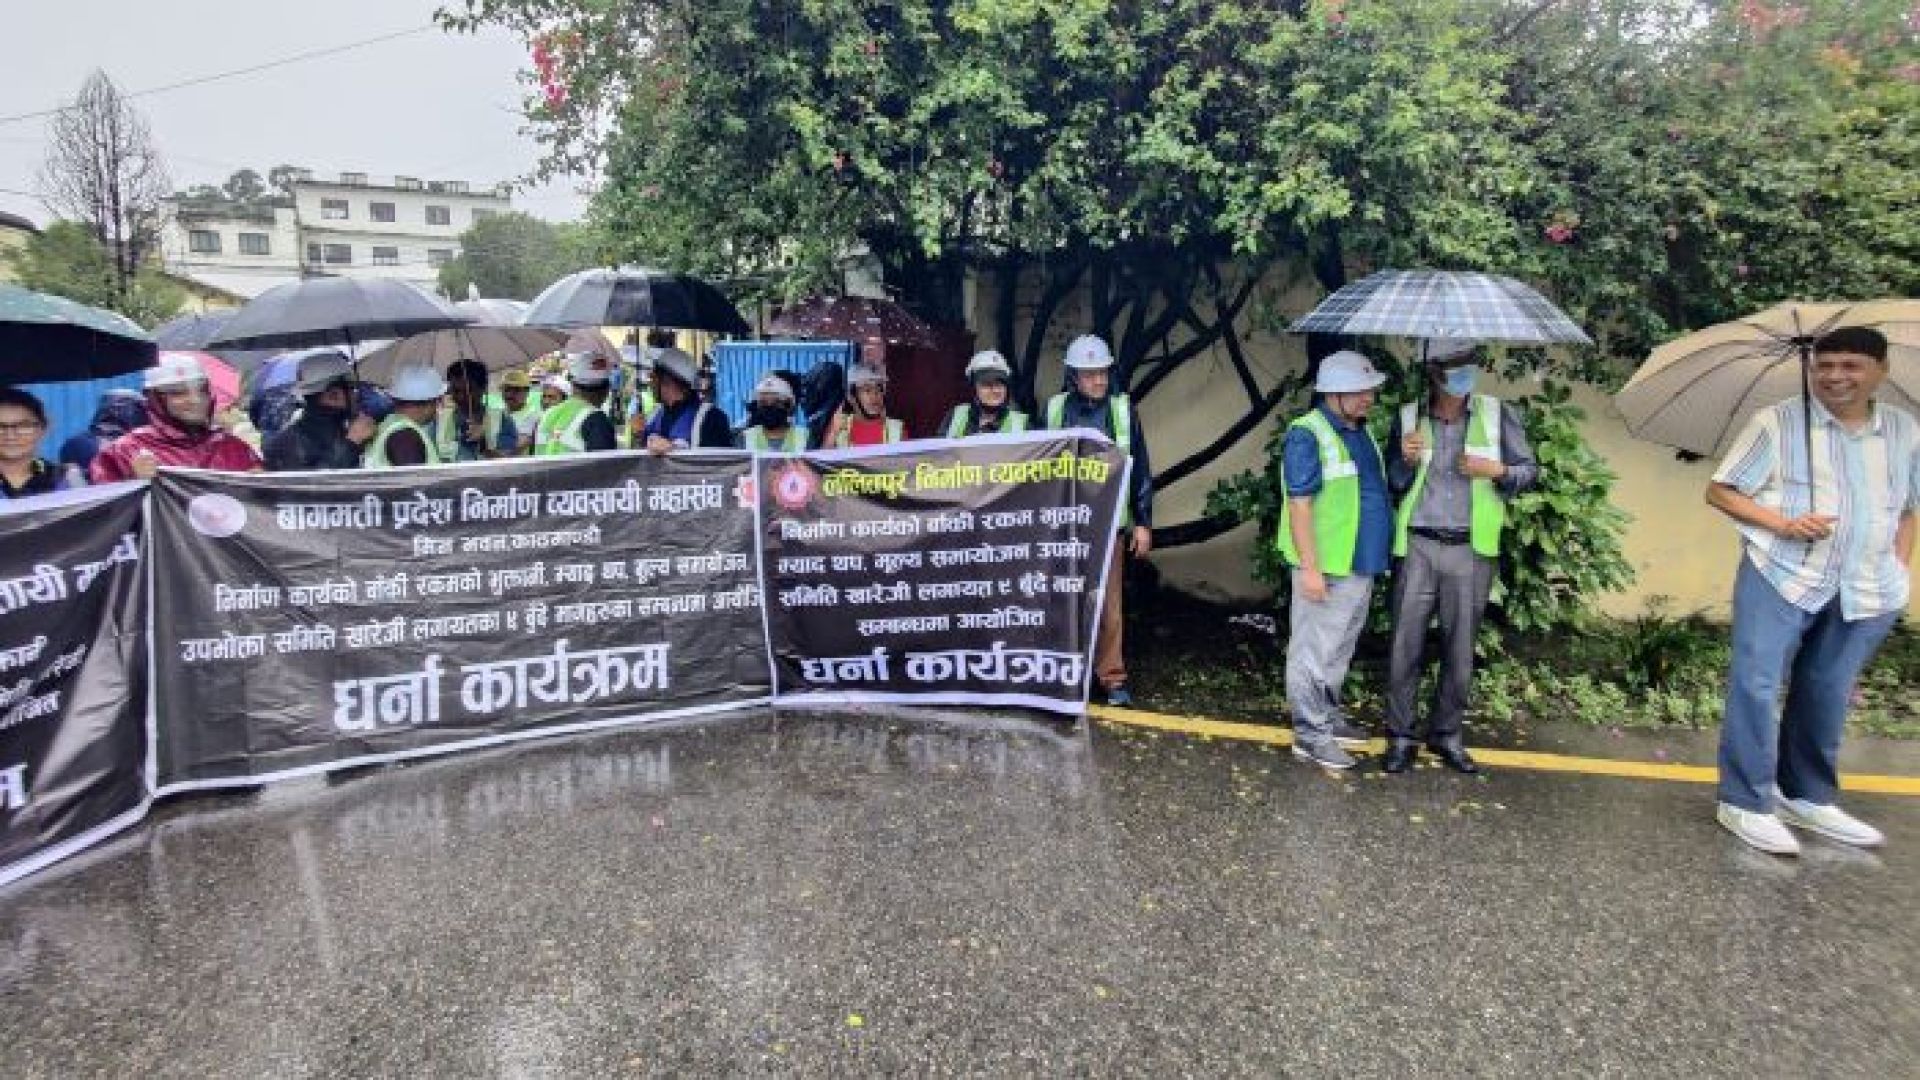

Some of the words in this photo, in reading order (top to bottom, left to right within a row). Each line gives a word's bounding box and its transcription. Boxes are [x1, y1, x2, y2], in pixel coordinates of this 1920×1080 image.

[822, 468, 907, 501] ललितपुर
[915, 461, 982, 493] निर्माण
[989, 452, 1075, 485] व्यवसायी
[277, 493, 384, 530] बागमती
[392, 491, 452, 529] प्रदेश
[460, 487, 541, 521] निर्माण
[546, 479, 642, 516] व्यवसायी
[648, 479, 723, 513] महासंघ
[780, 517, 845, 542] निर्माण
[852, 515, 920, 540] कार्यको
[981, 509, 1034, 531] रकम
[778, 555, 826, 575] म्याद
[874, 552, 922, 576] मूल्य
[929, 543, 1029, 569] समायोजन
[214, 584, 281, 611] निर्माण
[288, 576, 357, 606] कार्यको
[415, 567, 481, 597] रकमको
[778, 584, 837, 608] समिति
[844, 580, 911, 607] खारेजी
[918, 580, 993, 604] लगायत
[179, 629, 264, 662] उपभोक्ता
[272, 624, 336, 654] समिति
[343, 616, 406, 648] खारेजी
[413, 611, 500, 641] लगायतका
[956, 605, 1045, 630] आयोजित
[332, 655, 445, 730] धर्ना
[460, 638, 672, 714] कार्यक्रम
[800, 646, 890, 683] धर्ना
[905, 641, 1085, 687] कार्यक्रम
